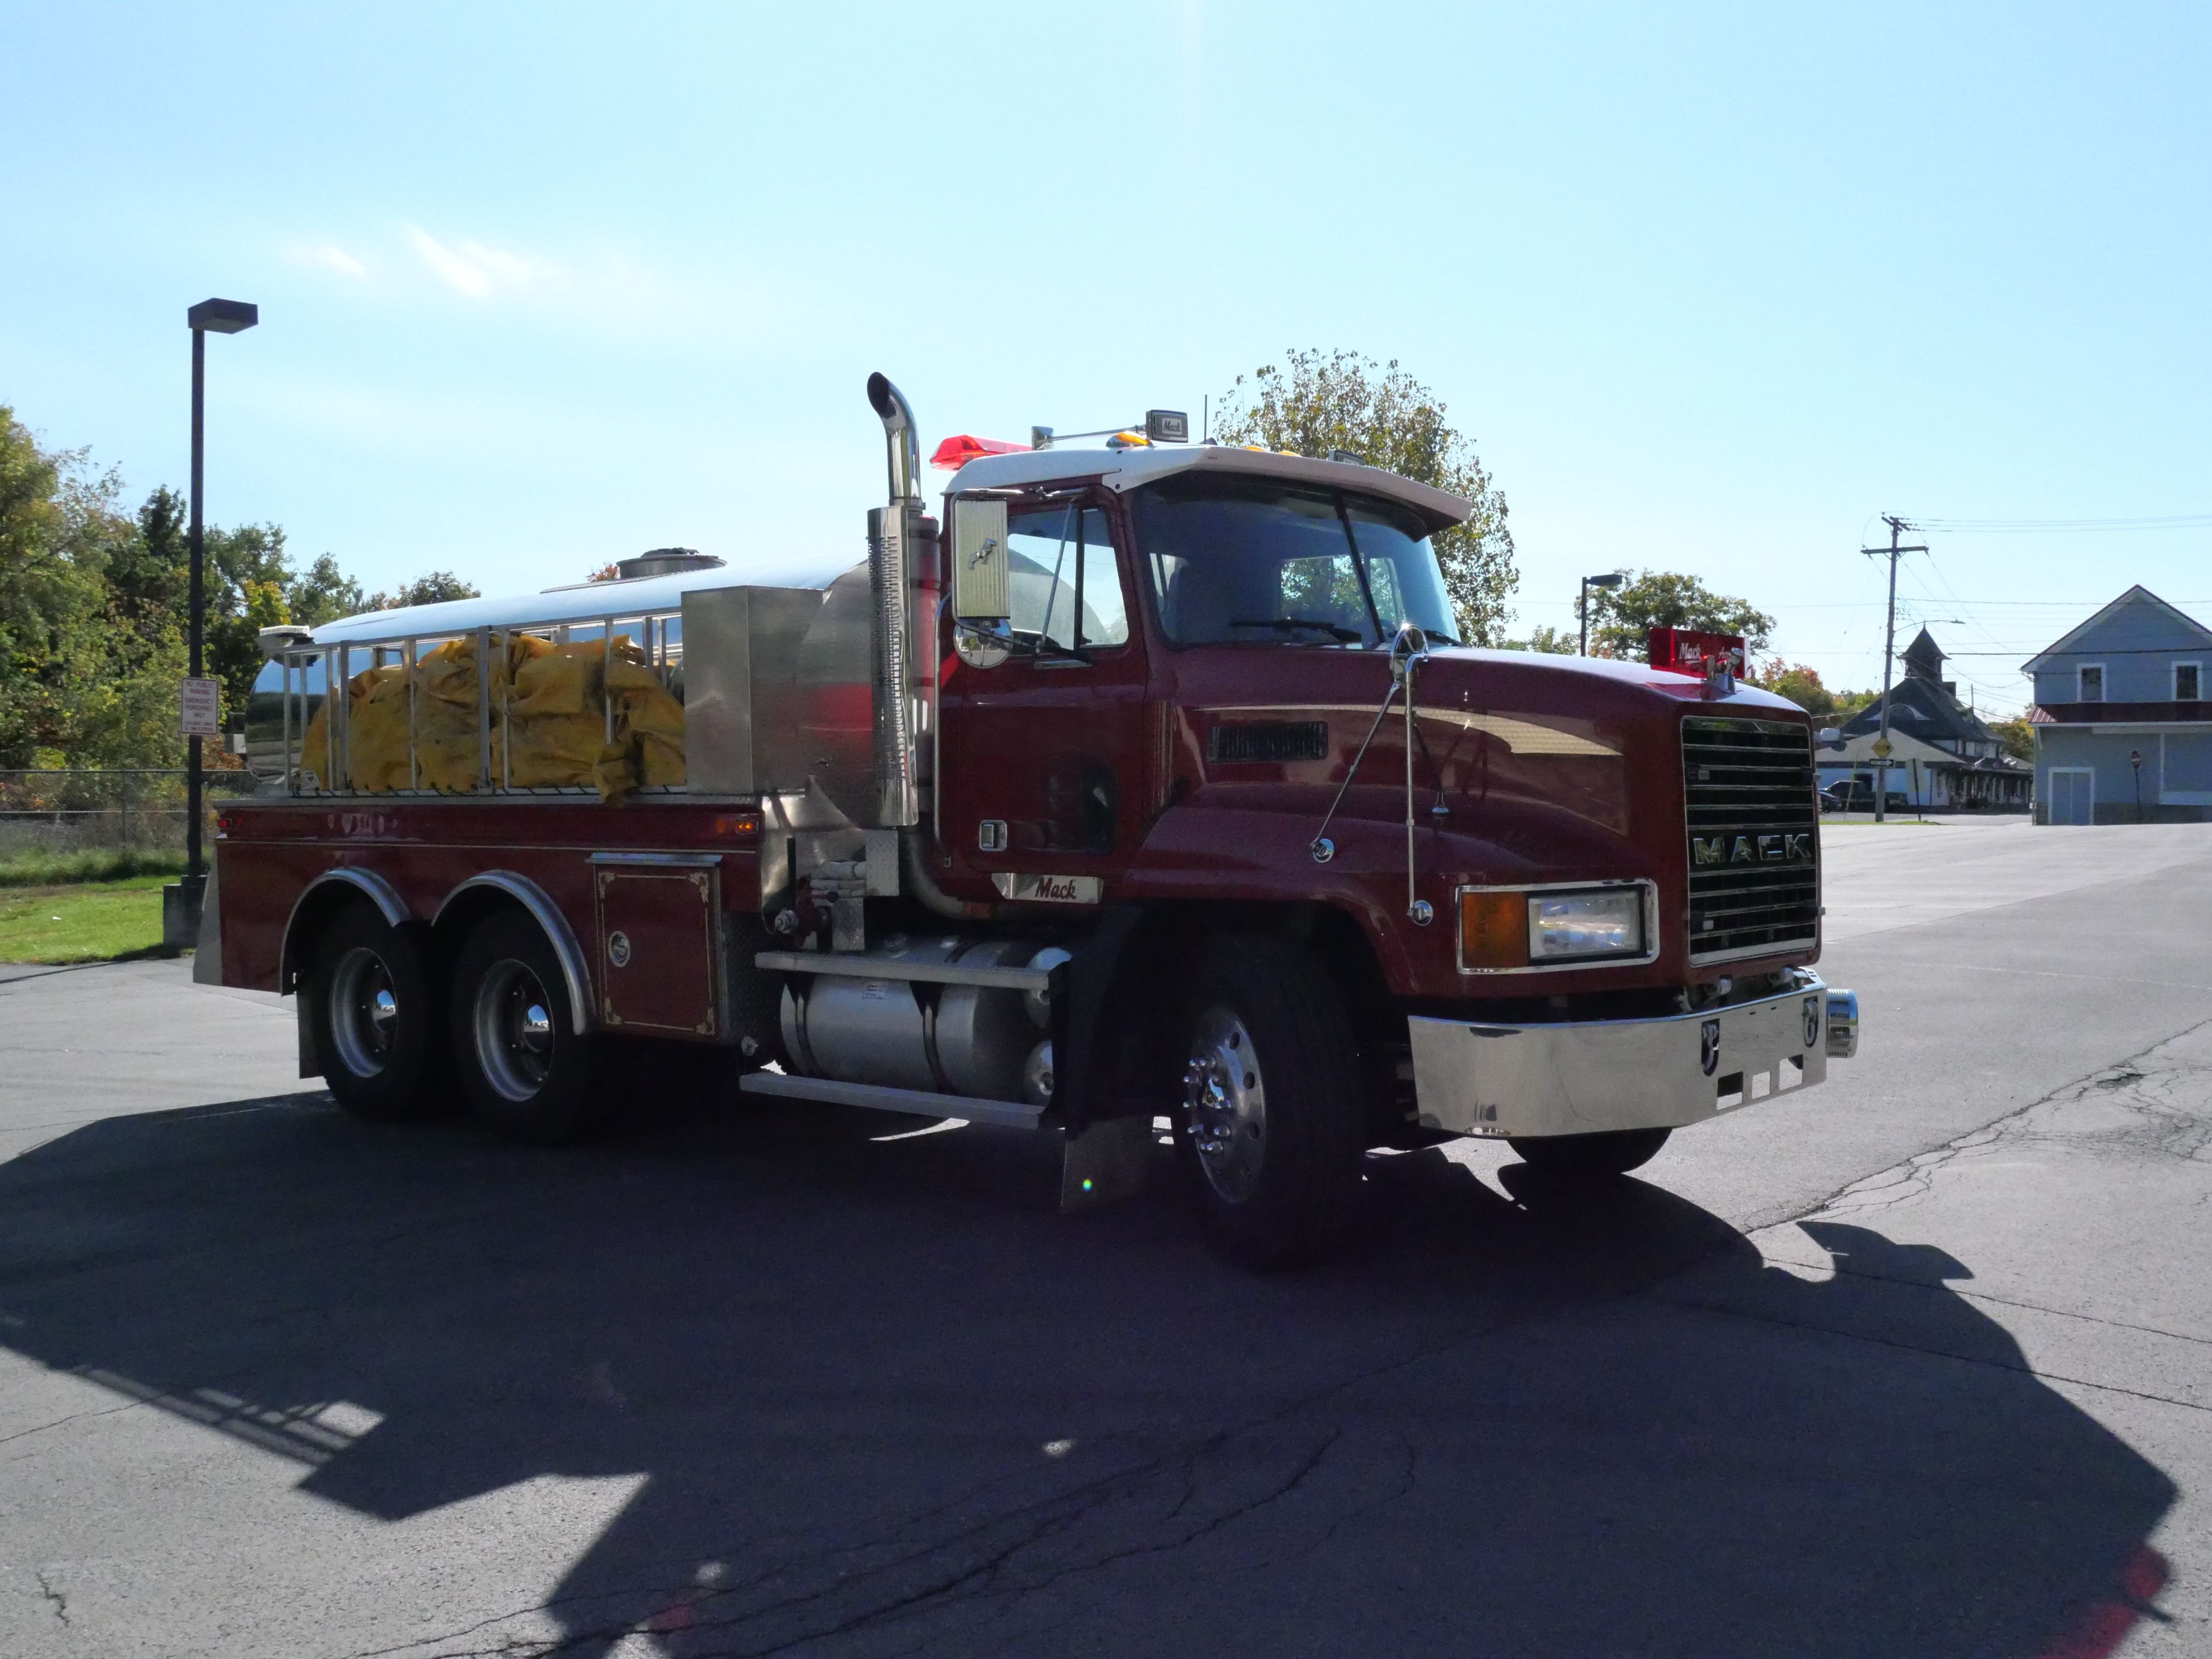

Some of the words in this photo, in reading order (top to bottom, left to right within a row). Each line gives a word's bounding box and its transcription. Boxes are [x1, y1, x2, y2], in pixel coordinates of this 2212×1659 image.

[1164, 420, 1181, 433] Mack
[1678, 642, 1702, 661] Mack
[1693, 833, 1812, 864] MACK
[1034, 877, 1077, 900] Mack
